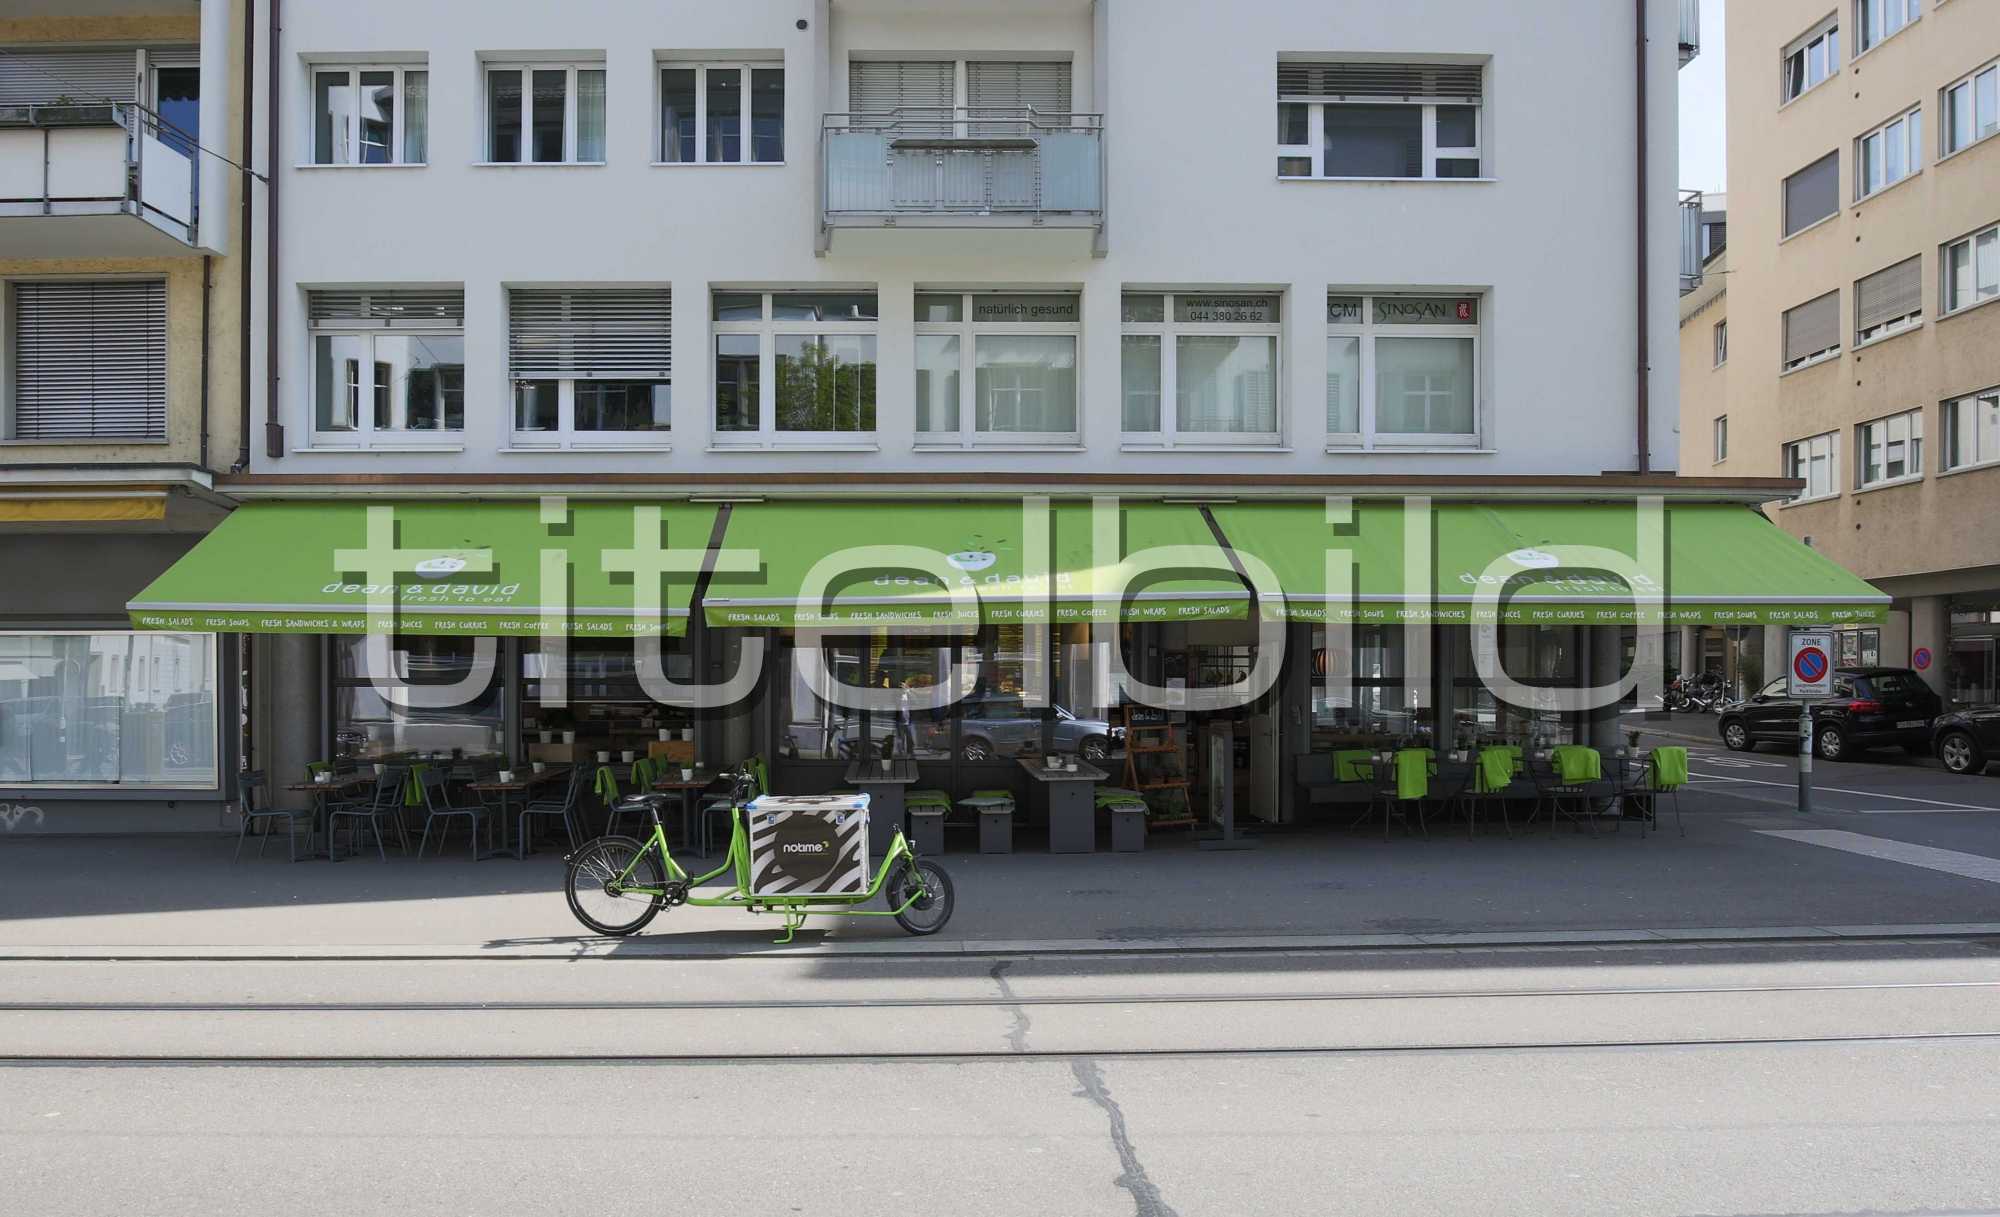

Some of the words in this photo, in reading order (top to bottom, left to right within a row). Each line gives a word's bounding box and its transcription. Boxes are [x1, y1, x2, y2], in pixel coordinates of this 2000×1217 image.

[979, 303, 1027, 314] natürlich
[1031, 303, 1073, 316] gesund
[1190, 311, 1209, 321] 044
[1213, 311, 1231, 321] 380
[1234, 311, 1247, 321] 26
[1378, 301, 1447, 321] SINOSAN
[873, 573, 949, 586] dean
[959, 575, 976, 586] &
[985, 572, 1072, 585] david
[1459, 571, 1535, 584] dean
[322, 581, 398, 594] dean
[406, 584, 424, 594] &
[431, 582, 521, 595] david
[400, 594, 449, 602] fresh
[459, 595, 475, 603] to
[728, 613, 750, 622] FRESH
[754, 613, 780, 622] SALADS
[794, 613, 815, 621] FRESH
[851, 611, 872, 620] FRESH
[876, 611, 922, 620] SANDWICHES
[933, 610, 953, 619] FRESH
[991, 609, 1013, 618] FRESH
[1016, 609, 1044, 618] CURRIES
[1056, 608, 1078, 617] FRESH
[1081, 608, 1107, 617] COFFEE
[1143, 607, 1167, 616] WRAPS
[1178, 606, 1200, 615] FRESH
[1203, 605, 1231, 615] SALADS
[1300, 608, 1327, 617] SALADS
[1396, 609, 1417, 618] FRESH
[1420, 609, 1466, 619] SANDWICHES
[1476, 610, 1496, 619] FRESH
[1498, 610, 1521, 619] UICES
[1532, 610, 1553, 619] FRESH
[1557, 610, 1585, 619] CURRIES
[1596, 610, 1617, 619] FRESH
[1620, 610, 1645, 619] COFFEE
[1679, 610, 1702, 619] WRAPS
[1714, 610, 1734, 619] FRESH
[1769, 610, 1791, 619] FRESH
[1793, 610, 1818, 619] SALADS
[1831, 609, 1852, 619] FRESH
[142, 616, 165, 626] FRESH
[168, 617, 193, 626] SALADS
[206, 618, 226, 627] FRESH
[261, 619, 282, 628] FRESH
[286, 619, 329, 628] SANDWICHES
[341, 619, 365, 629] WRAPS
[400, 620, 424, 629] JUICES
[434, 620, 456, 630] FRESH
[459, 621, 488, 630] CURRIES
[499, 621, 521, 630] FRESH
[587, 622, 613, 631] SALADS
[625, 622, 646, 631] FRESH
[1801, 638, 1821, 646] ZONE
[783, 841, 823, 853] notime
